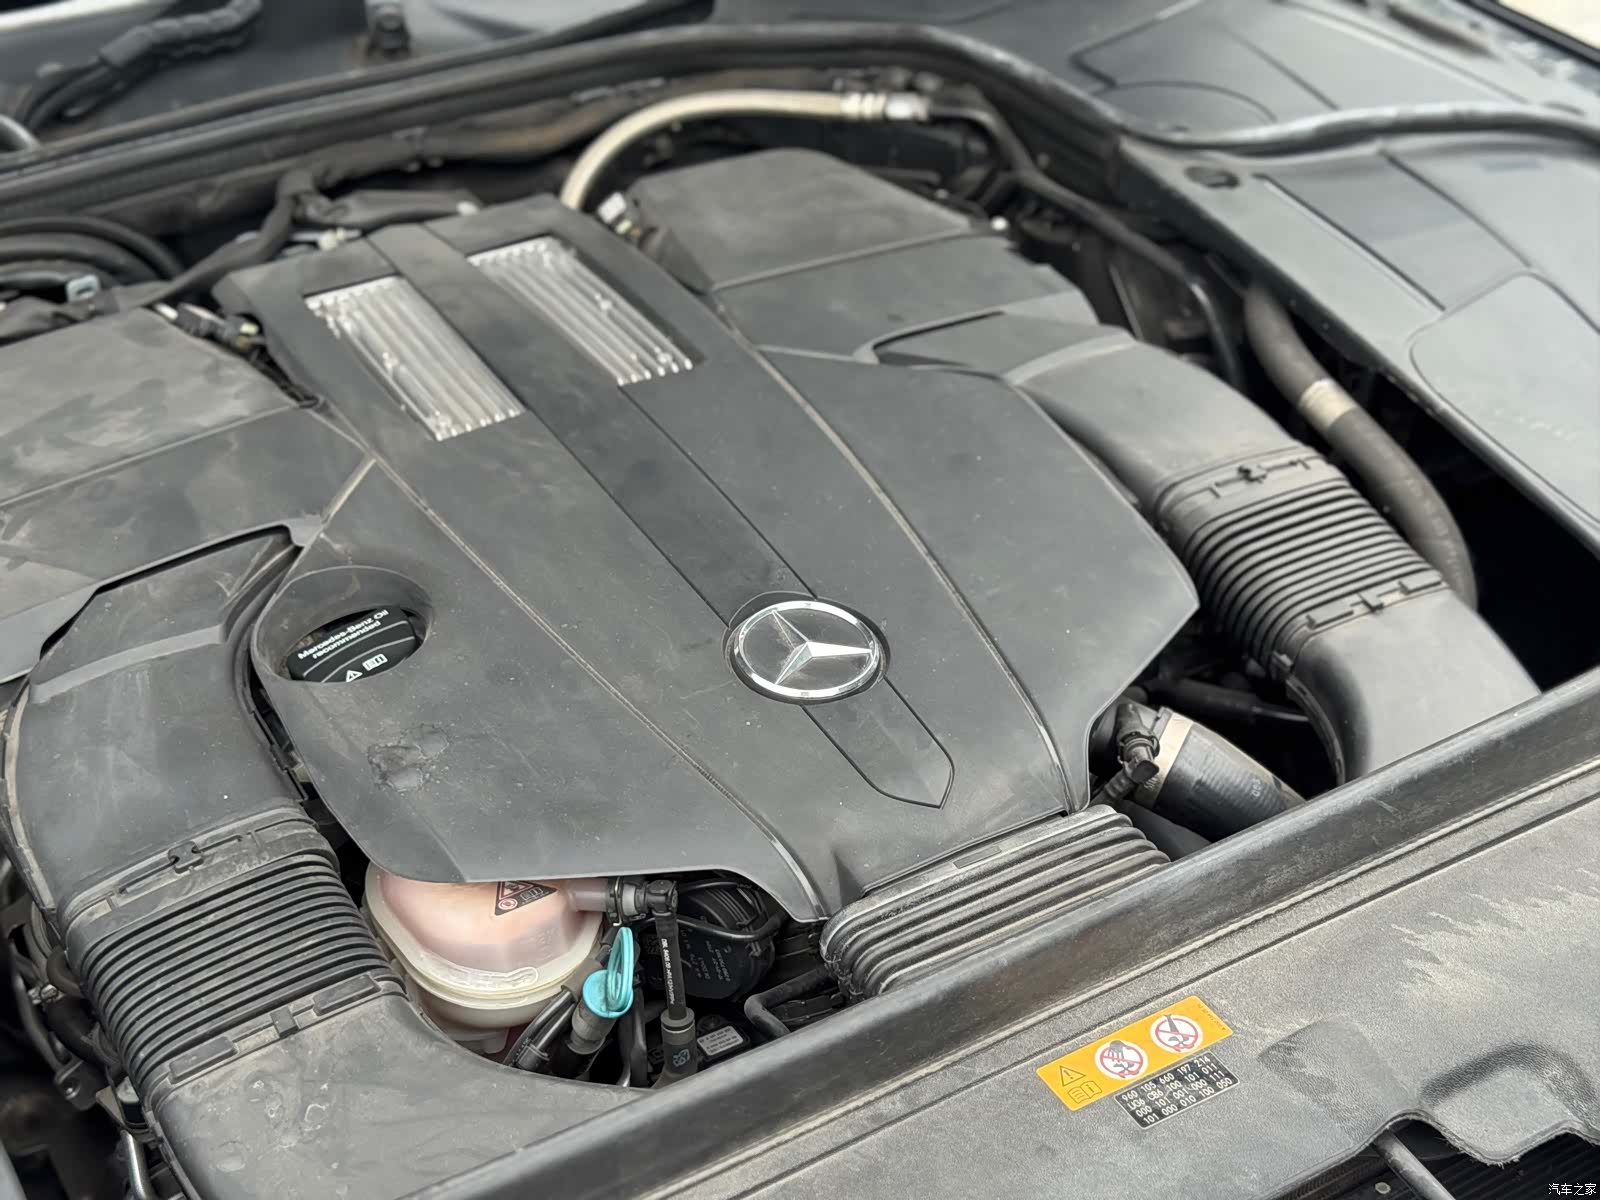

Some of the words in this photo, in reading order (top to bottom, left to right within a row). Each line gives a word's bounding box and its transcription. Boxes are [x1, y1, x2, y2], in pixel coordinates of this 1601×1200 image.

[297, 617, 374, 660] Mercedes-Benz
[373, 609, 389, 620] Oil
[312, 620, 382, 659] recommended
[1122, 1090, 1138, 1102] 960
[1141, 1082, 1156, 1093] 105
[1159, 1073, 1174, 1084] 660
[1177, 1064, 1191, 1076] 197
[1194, 1056, 1211, 1067] 214
[1136, 1105, 1152, 1117] 000
[1155, 1097, 1171, 1108] 101
[1173, 1088, 1189, 1099] 001
[1191, 1079, 1207, 1091] 000
[1210, 1071, 1224, 1081] 111
[1166, 1081, 1182, 1092] 100
[1184, 1072, 1199, 1083] 101
[1202, 1063, 1217, 1074] 011
[1144, 1114, 1159, 1125] 101
[1162, 1104, 1178, 1116] 000
[1180, 1095, 1196, 1107] 010
[1199, 1087, 1214, 1097] 100
[1216, 1078, 1233, 1090] 050
